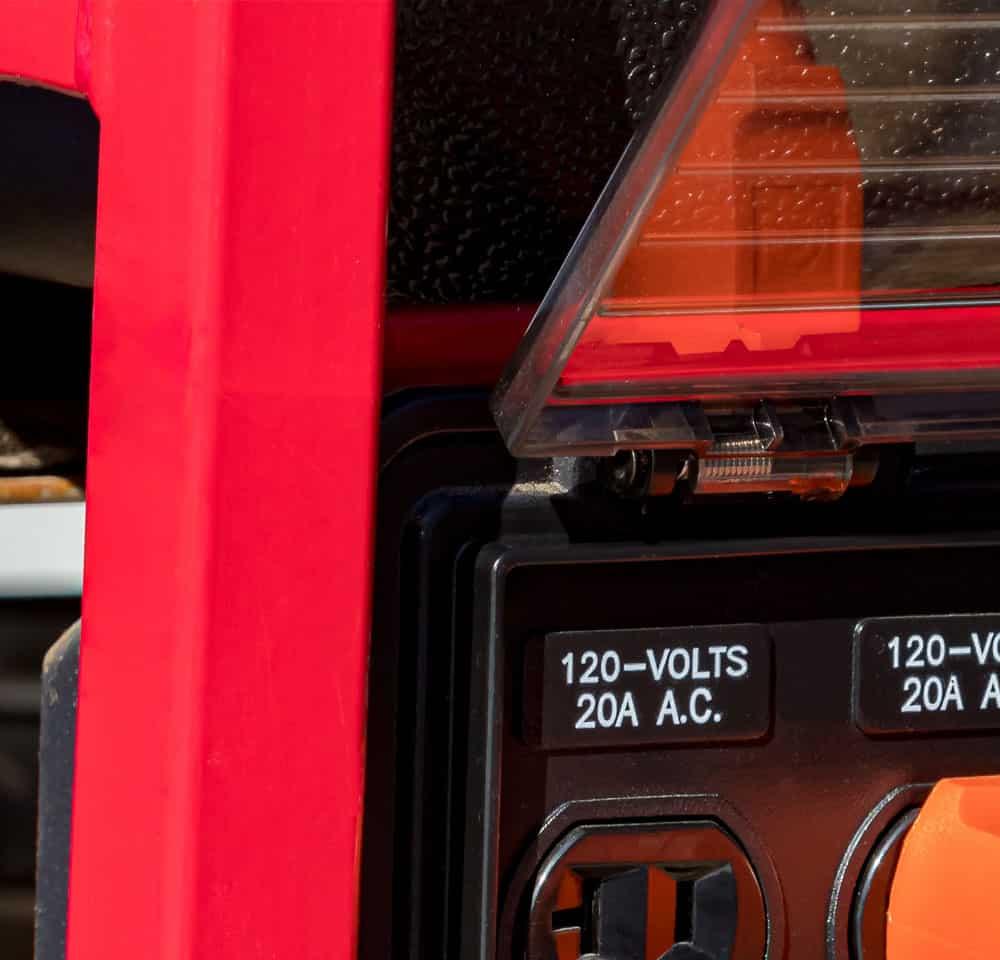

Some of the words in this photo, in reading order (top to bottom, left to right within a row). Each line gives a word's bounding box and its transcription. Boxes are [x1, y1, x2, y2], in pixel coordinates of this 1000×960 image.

[561, 644, 749, 685] 120-VOLTS
[574, 691, 639, 730] 20A
[655, 686, 722, 726] A.C.
[900, 674, 964, 713] 20A
